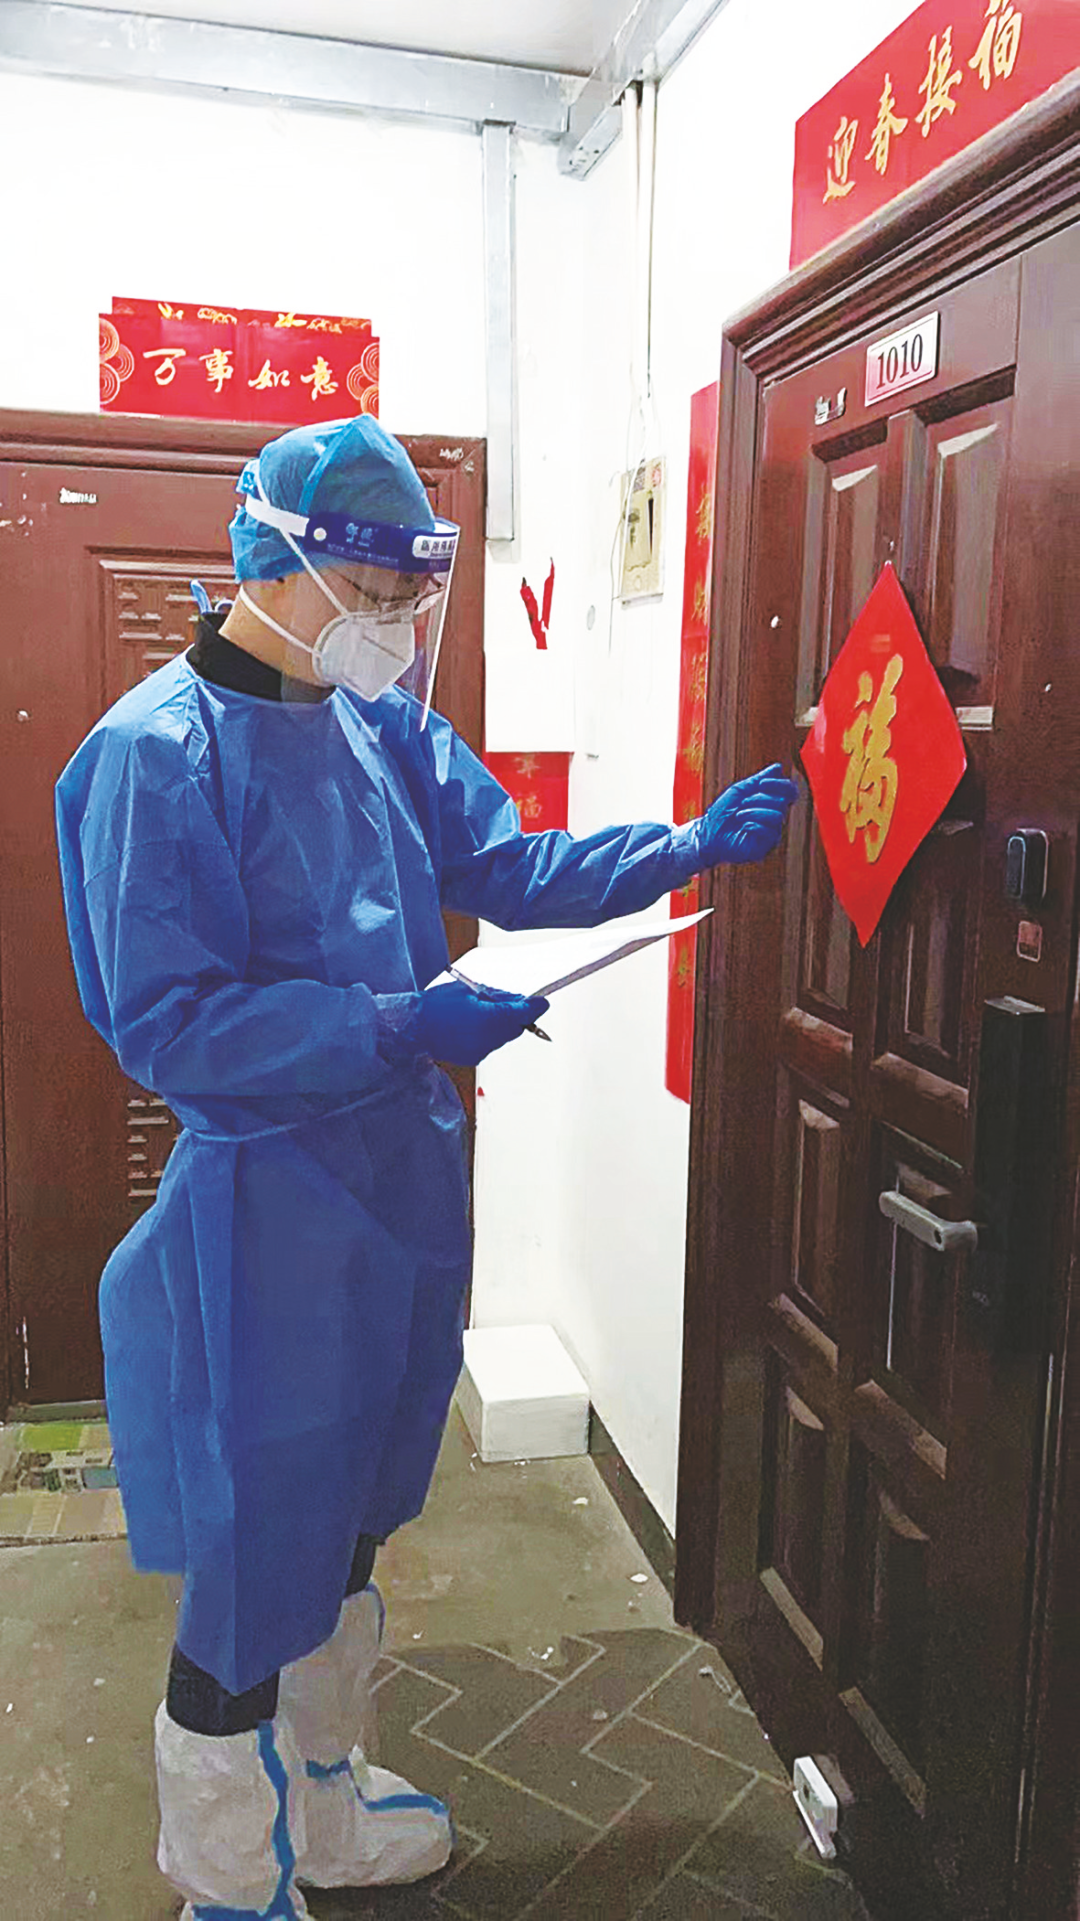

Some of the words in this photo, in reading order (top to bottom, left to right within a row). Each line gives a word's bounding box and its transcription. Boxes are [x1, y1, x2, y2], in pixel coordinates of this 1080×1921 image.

[822, 0, 1023, 204] 迎春接福
[142, 347, 339, 401] 万事如意
[875, 333, 924, 390] 1010
[838, 652, 904, 864] 福
